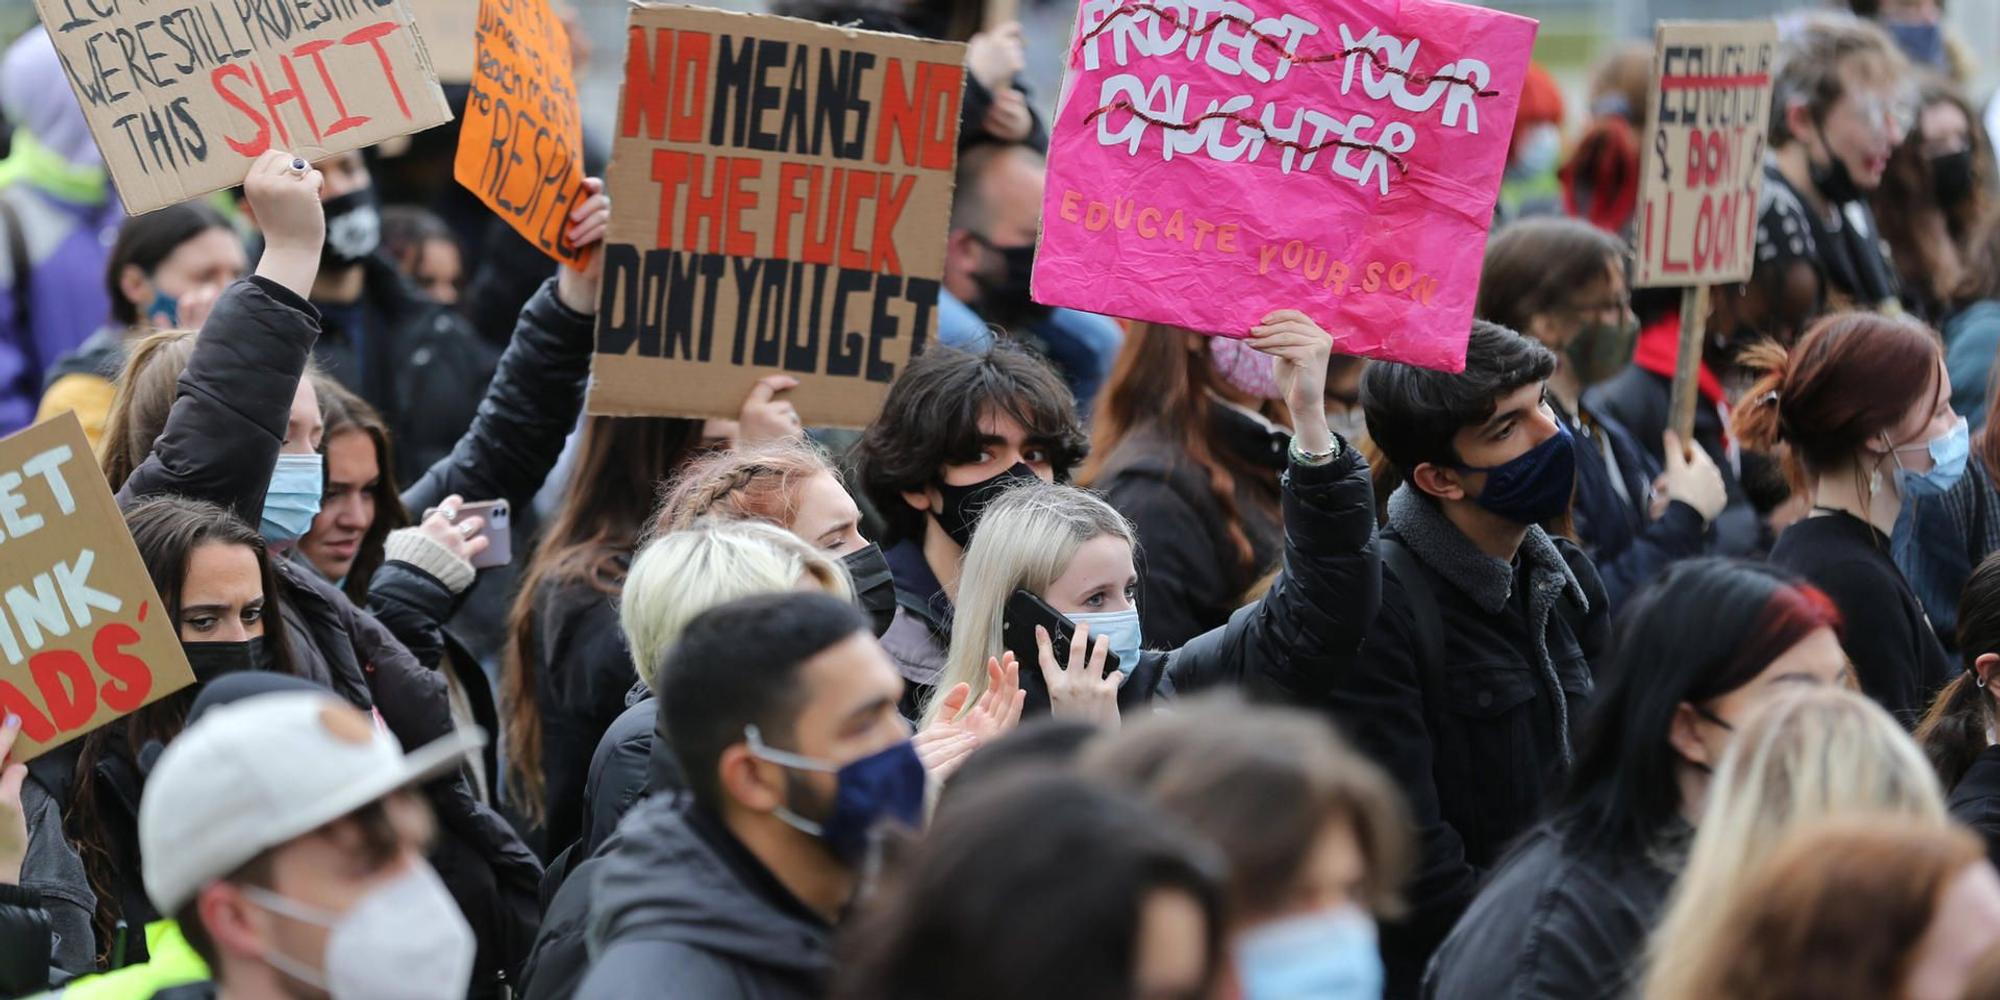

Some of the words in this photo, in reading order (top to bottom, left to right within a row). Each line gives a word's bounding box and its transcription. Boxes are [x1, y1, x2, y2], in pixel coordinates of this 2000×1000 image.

[112, 96, 208, 175] THIS
[211, 22, 412, 157] SHIT
[622, 25, 711, 142] NO
[709, 34, 876, 161] MEANS
[874, 57, 964, 171] NO
[1082, 0, 1319, 83] PROTECT
[1338, 23, 1491, 134] YOUR
[1097, 73, 1415, 195] DAUGHTER
[480, 98, 592, 262] RESPEC
[651, 148, 762, 258] THE
[772, 161, 917, 276] FUCK
[596, 243, 725, 362] DONT
[731, 255, 830, 374] YOU
[826, 268, 941, 382] GET
[1060, 190, 1239, 253] EDUCATE
[1258, 239, 1351, 297] YOUR
[1361, 261, 1440, 306] SON
[0, 444, 75, 544] ET
